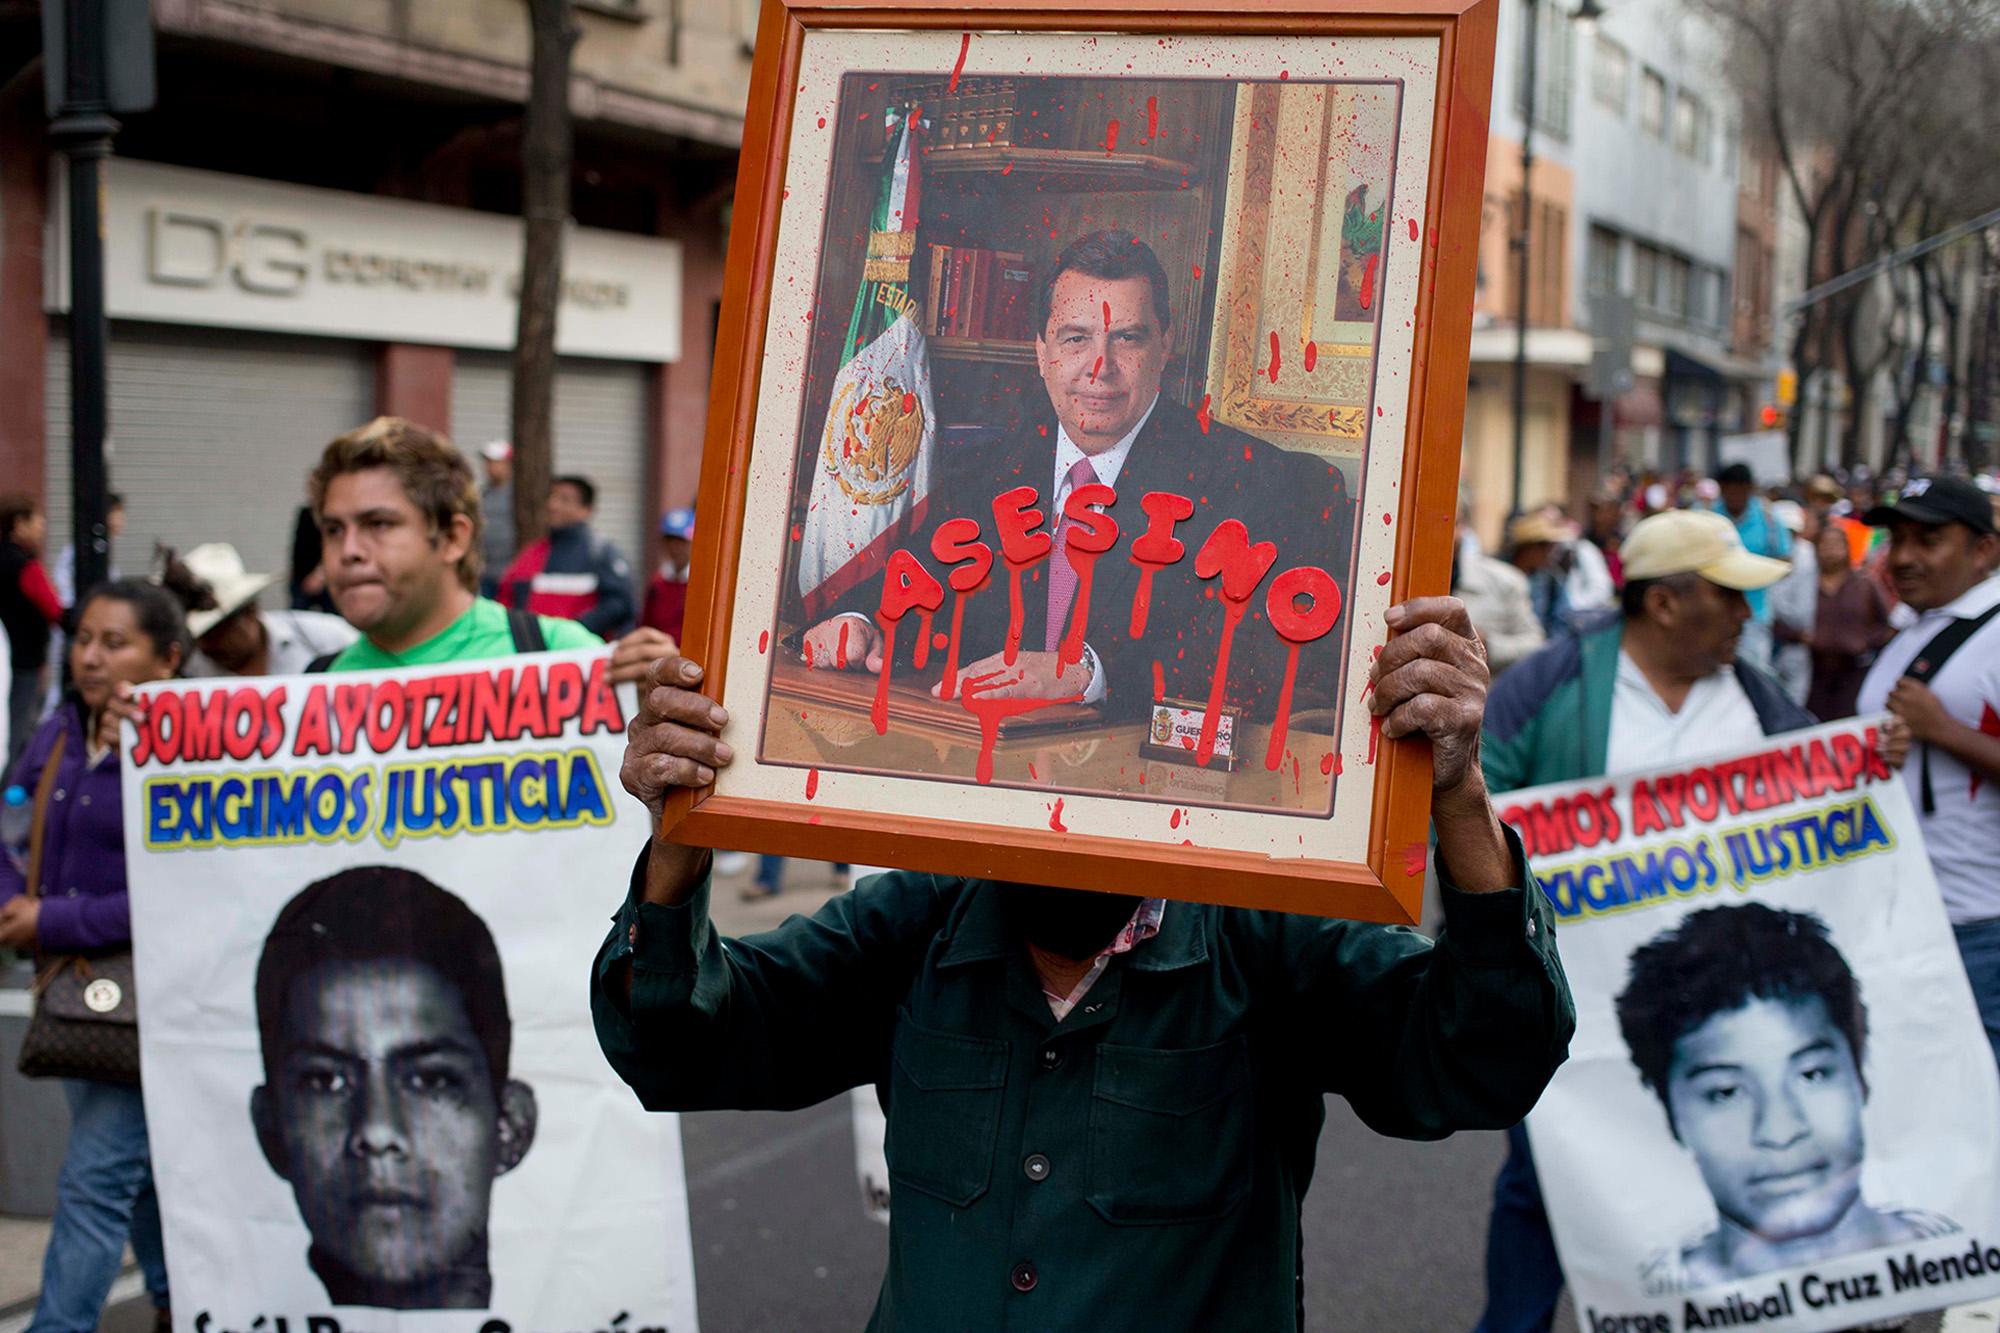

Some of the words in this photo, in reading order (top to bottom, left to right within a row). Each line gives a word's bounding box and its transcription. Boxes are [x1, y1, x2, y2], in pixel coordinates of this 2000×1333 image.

[145, 207, 308, 298] DG
[880, 484, 1342, 643] ASESINO
[131, 685, 287, 768] SOMOS
[292, 657, 626, 757] AYOTZINAPA
[148, 772, 372, 845] EXIGIMOS
[382, 755, 607, 838] JUSTICIA
[1500, 786, 1621, 860] OMOS
[1631, 727, 1891, 836] AYOTZINAPA
[1536, 840, 1719, 917] XIGIMOS
[1724, 801, 1890, 886] JUSTICIA
[1683, 1281, 1794, 1331] Anibal
[1800, 1273, 1882, 1308] Cruz
[1886, 1239, 2000, 1293] Mendo
